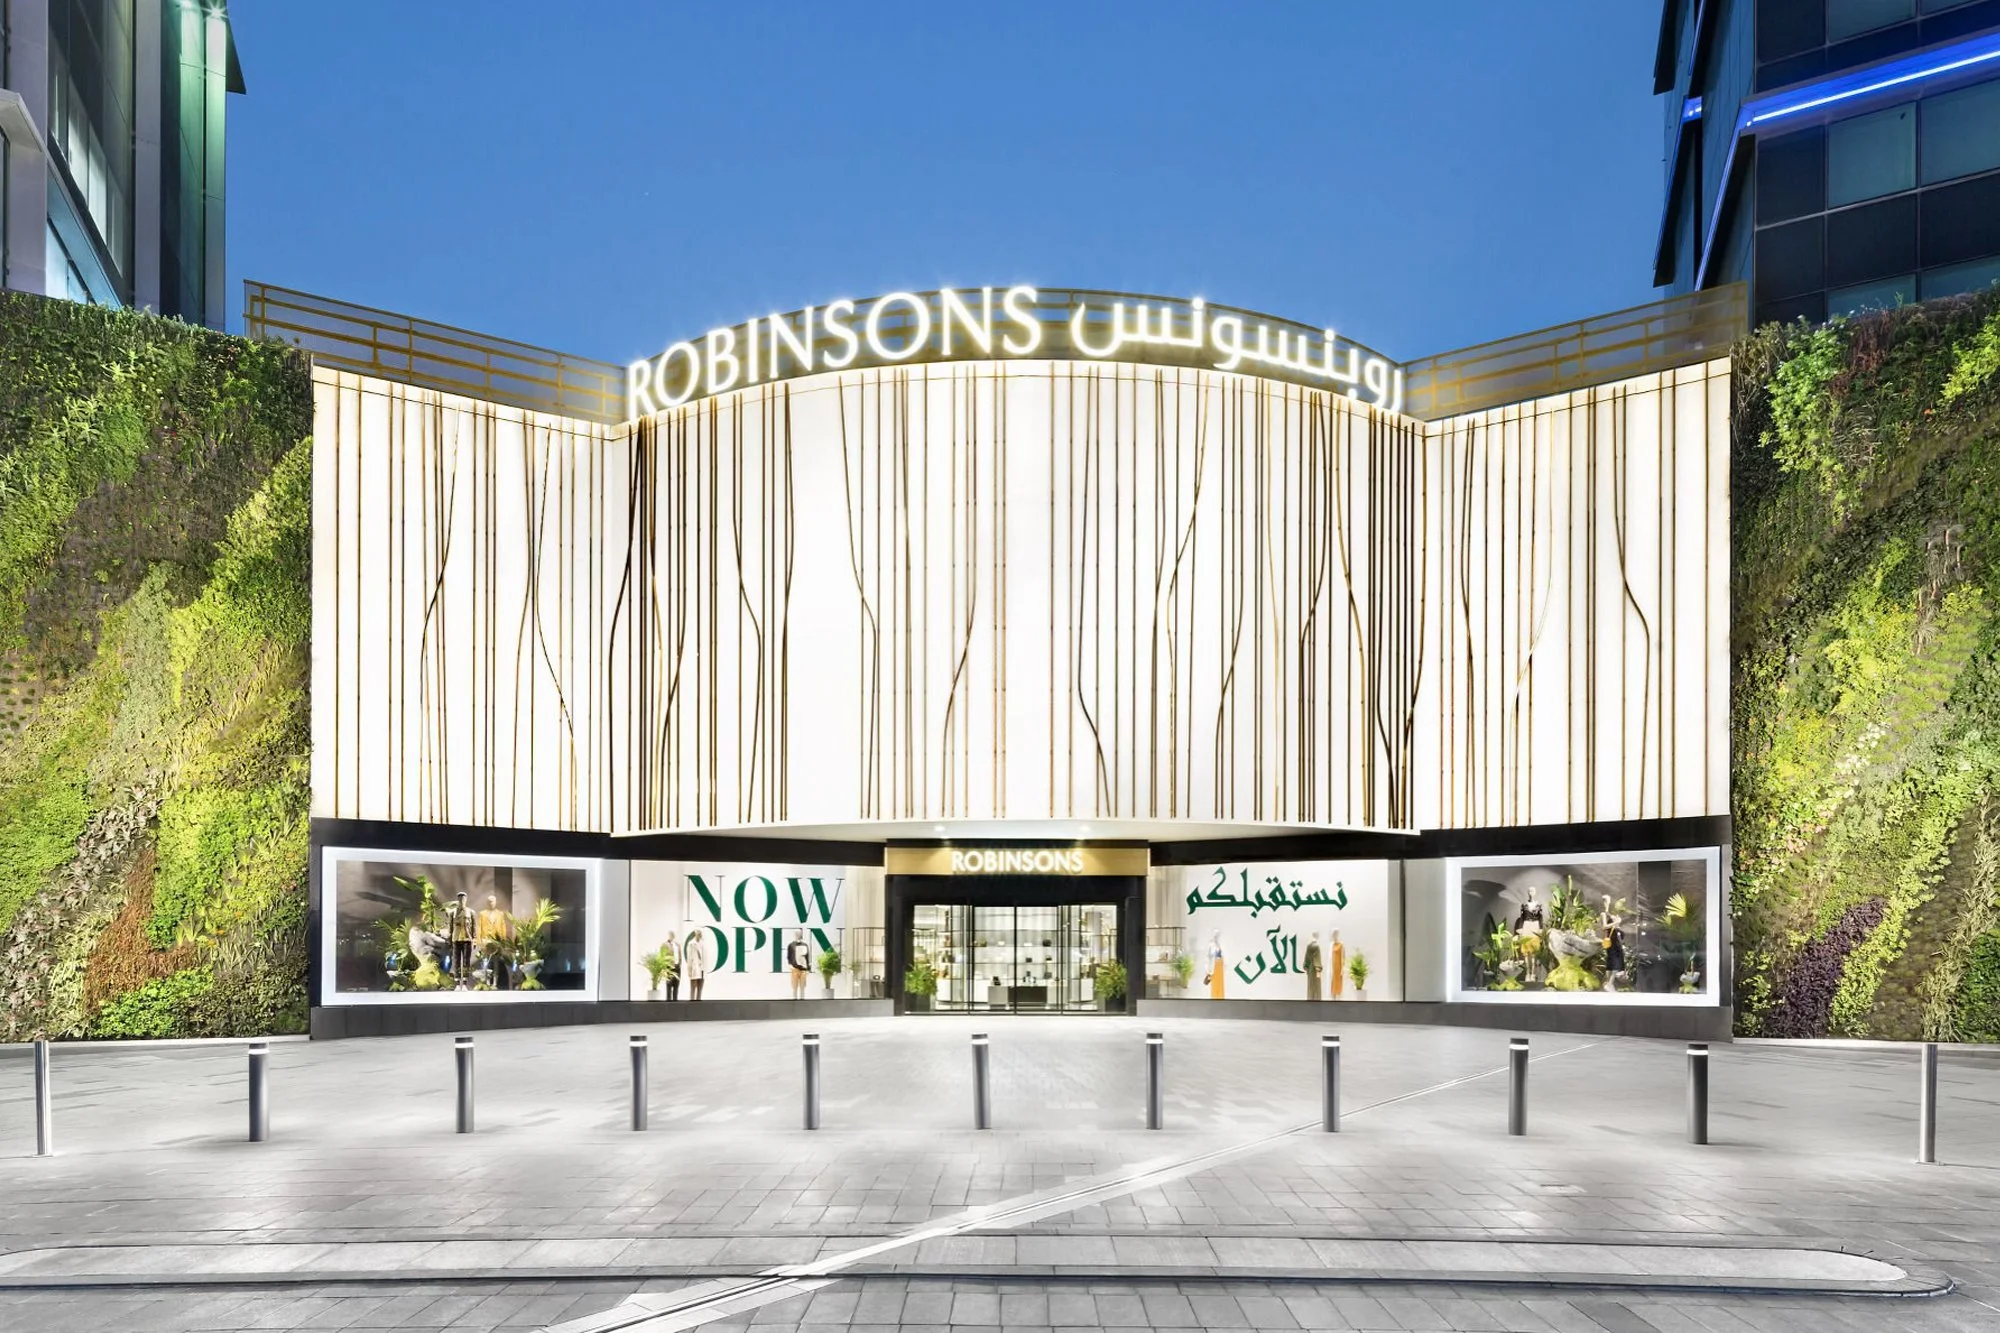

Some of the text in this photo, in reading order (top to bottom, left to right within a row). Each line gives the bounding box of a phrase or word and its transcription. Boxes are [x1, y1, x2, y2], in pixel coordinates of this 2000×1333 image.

[627, 285, 1042, 421] ROBINSONS
[1071, 296, 1402, 412] روبنسونس
[951, 851, 1083, 872] ROBINSONS
[684, 874, 845, 924] NOW
[1186, 866, 1348, 919] نستقبلكم
[1234, 924, 1306, 984] الآن
